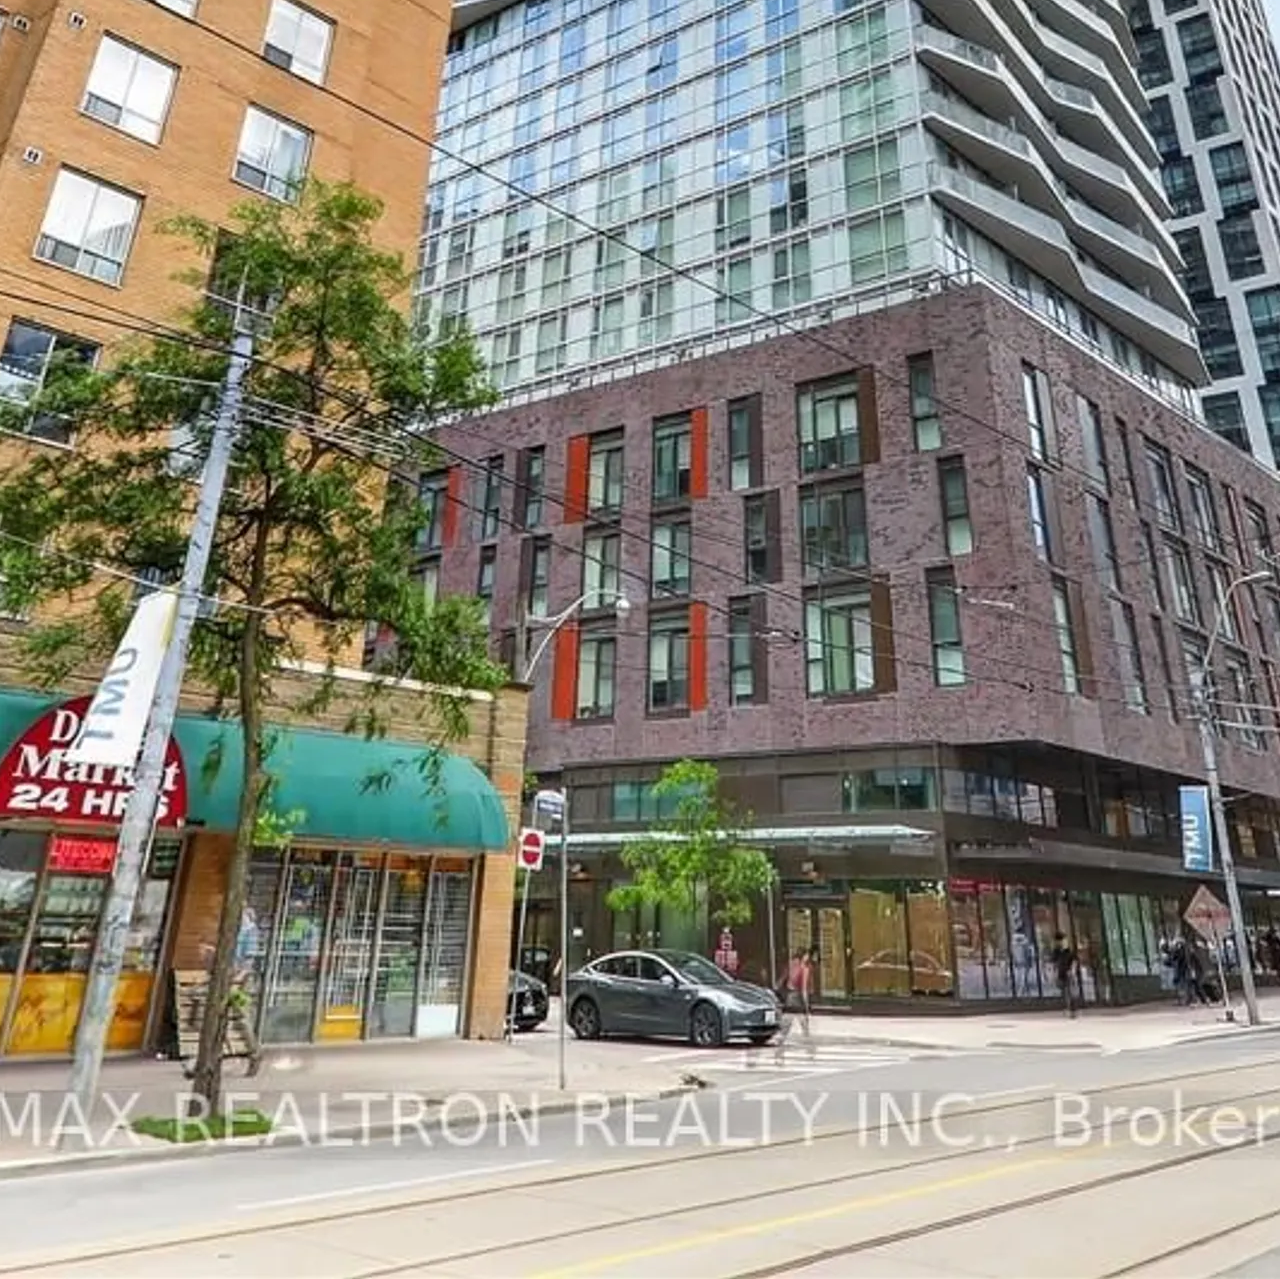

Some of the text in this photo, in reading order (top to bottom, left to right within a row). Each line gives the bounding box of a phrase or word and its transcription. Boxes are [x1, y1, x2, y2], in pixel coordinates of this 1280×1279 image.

[77, 647, 138, 749] TMU
[7, 783, 69, 812] 24
[1183, 814, 1203, 869] TMU
